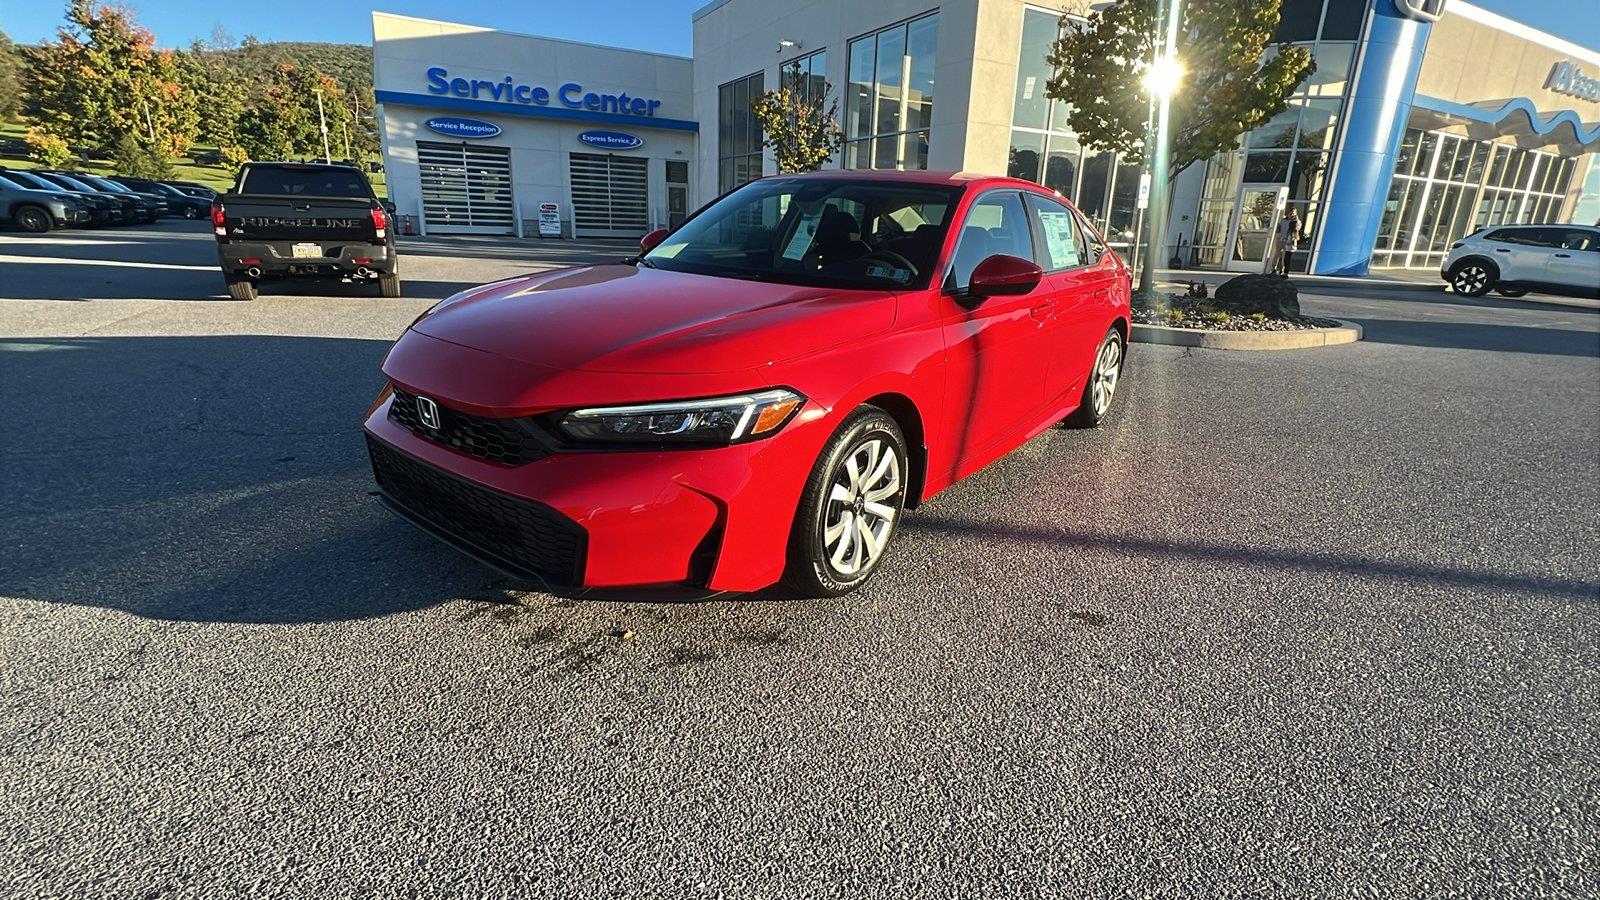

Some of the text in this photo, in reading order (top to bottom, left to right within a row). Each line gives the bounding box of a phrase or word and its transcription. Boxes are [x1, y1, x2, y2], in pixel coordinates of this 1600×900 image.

[427, 67, 662, 116] Service Center
[429, 120, 497, 133] Service Reception
[582, 134, 629, 144] Express Service
[240, 217, 362, 228] RIDGELINE
